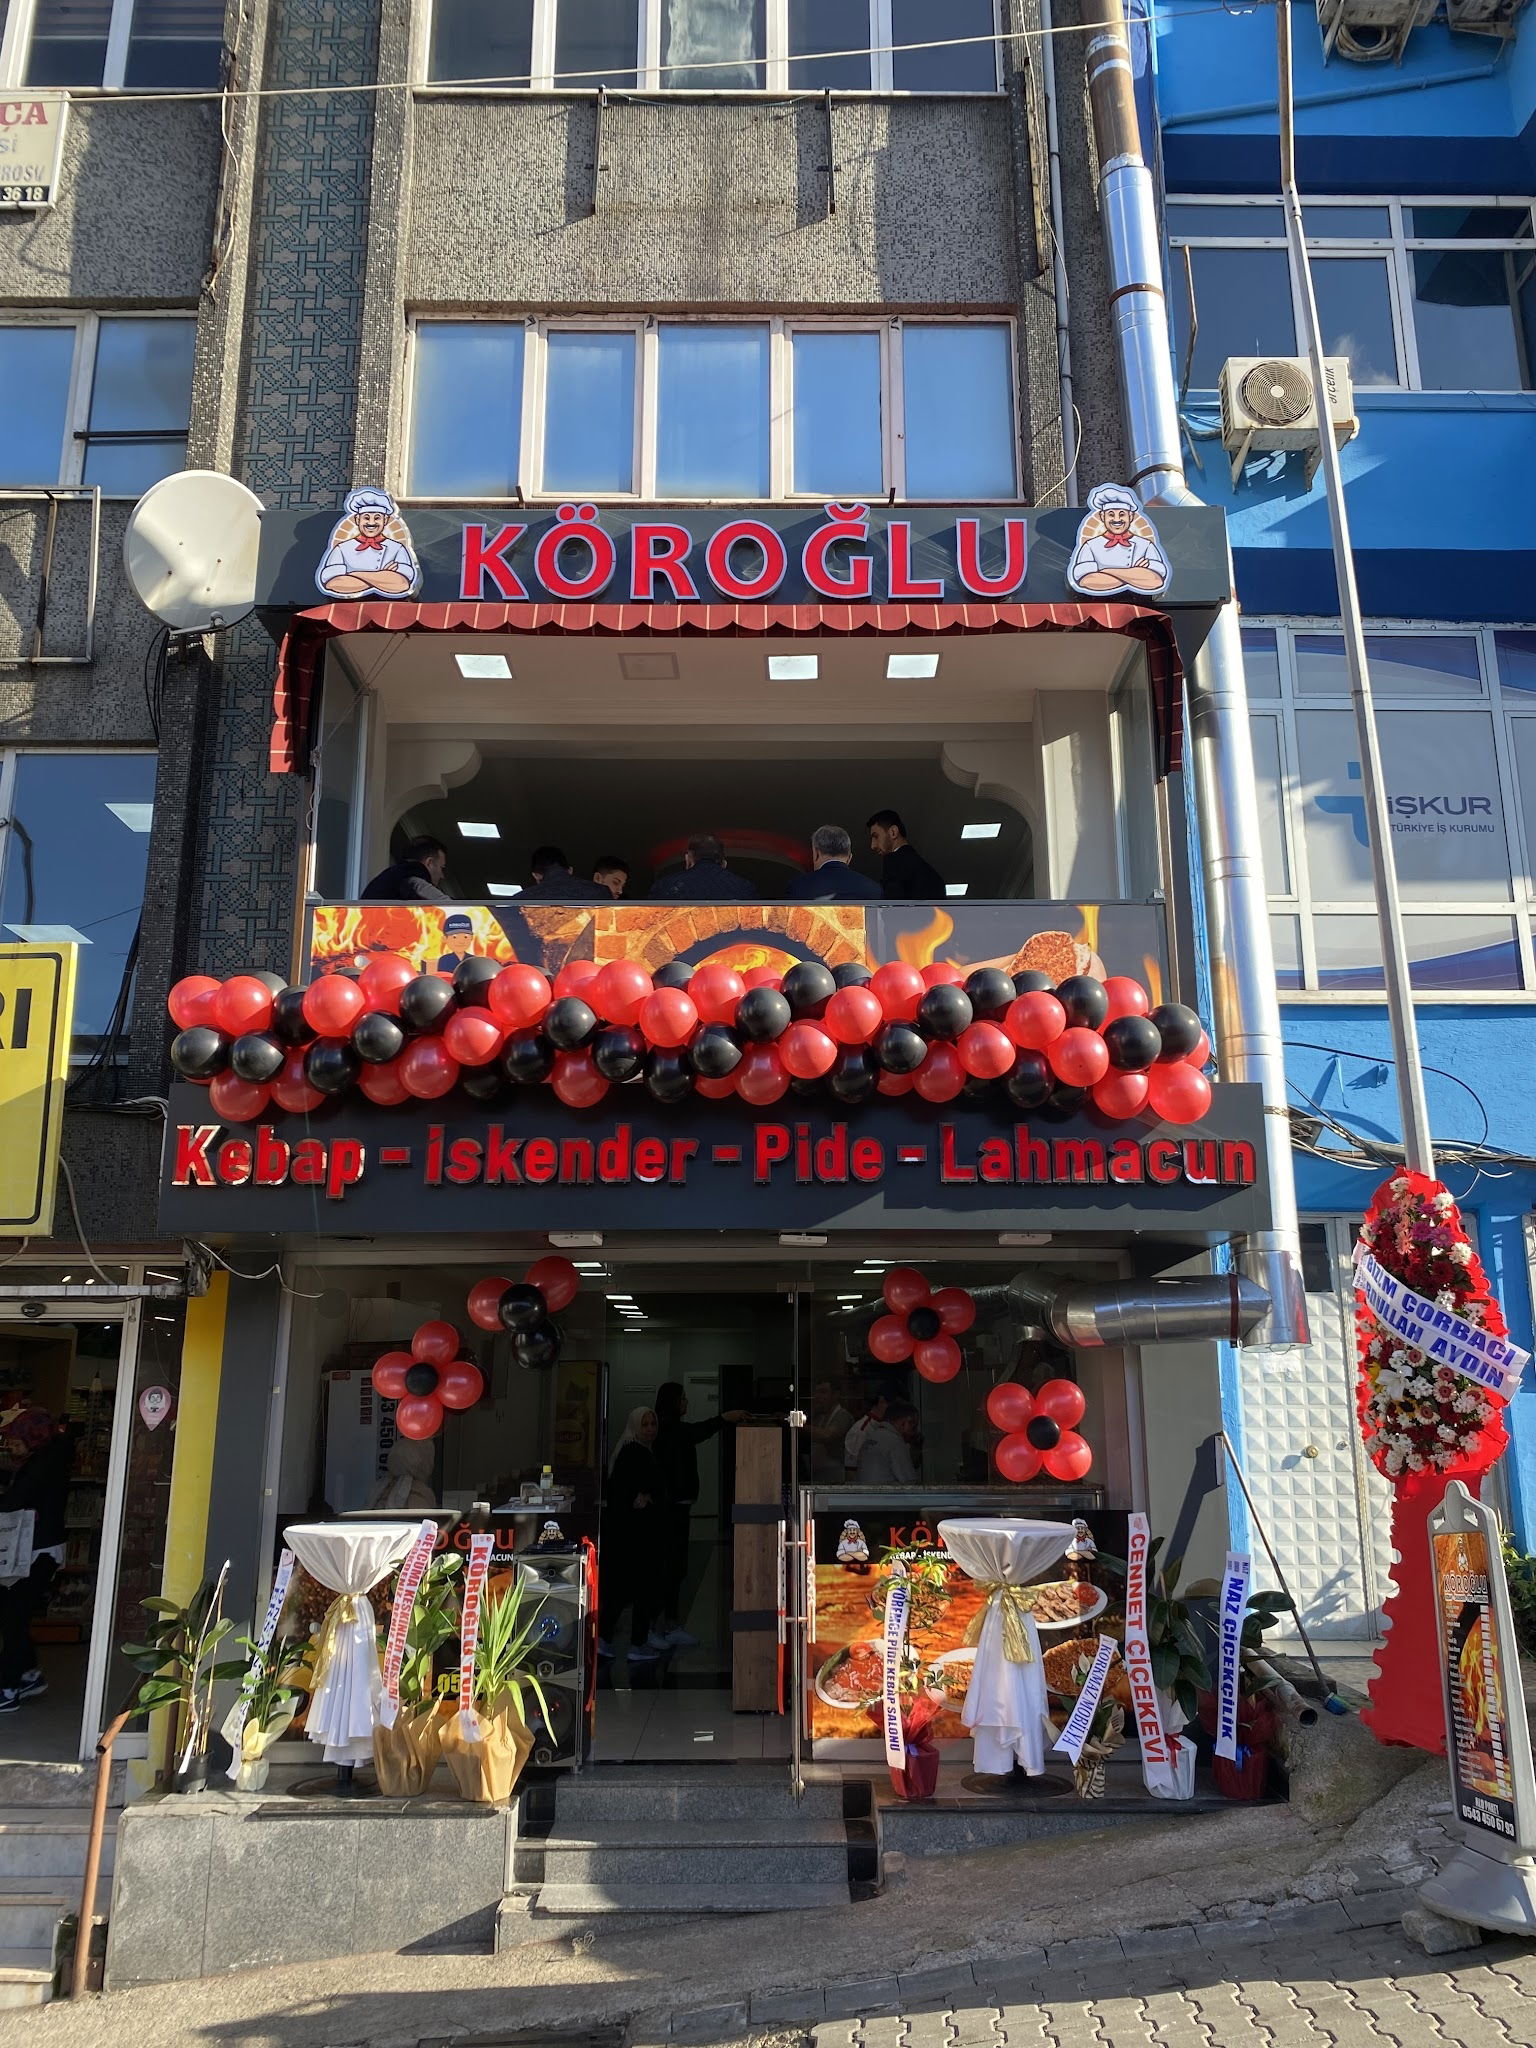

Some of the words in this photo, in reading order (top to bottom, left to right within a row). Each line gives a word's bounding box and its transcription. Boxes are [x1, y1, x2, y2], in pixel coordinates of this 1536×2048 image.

[3, 187, 21, 201] 36
[26, 187, 43, 201] 18
[459, 501, 1028, 600] KÖROĞLU
[1391, 823, 1435, 833] TÜRKİYE
[1437, 823, 1447, 834] İŞ
[1450, 824, 1495, 833] KURUMU
[171, 1124, 366, 1199] Kebap
[753, 1122, 885, 1182] Pide
[939, 1122, 1256, 1185] Lahmacun
[1402, 1293, 1516, 1367] ÇORBACI
[1429, 1337, 1505, 1389] AYDIN
[462, 1546, 488, 1655] KÖROĞLU
[1128, 1533, 1146, 1631] CENNET
[1225, 1577, 1244, 1615] NAZ
[886, 1639, 899, 1665] PİDE
[1084, 1644, 1112, 1701] KORKMAZ
[460, 1662, 472, 1711] TUR
[886, 1667, 897, 1704] KEBAP
[1125, 1639, 1169, 1763] ÇİÇEKEVİ
[1220, 1618, 1238, 1740] ÇİÇEKÇİLİK
[887, 1707, 901, 1752] SALONU
[1061, 1697, 1096, 1749] MOBİLYA
[1462, 1805, 1482, 1823] 0543
